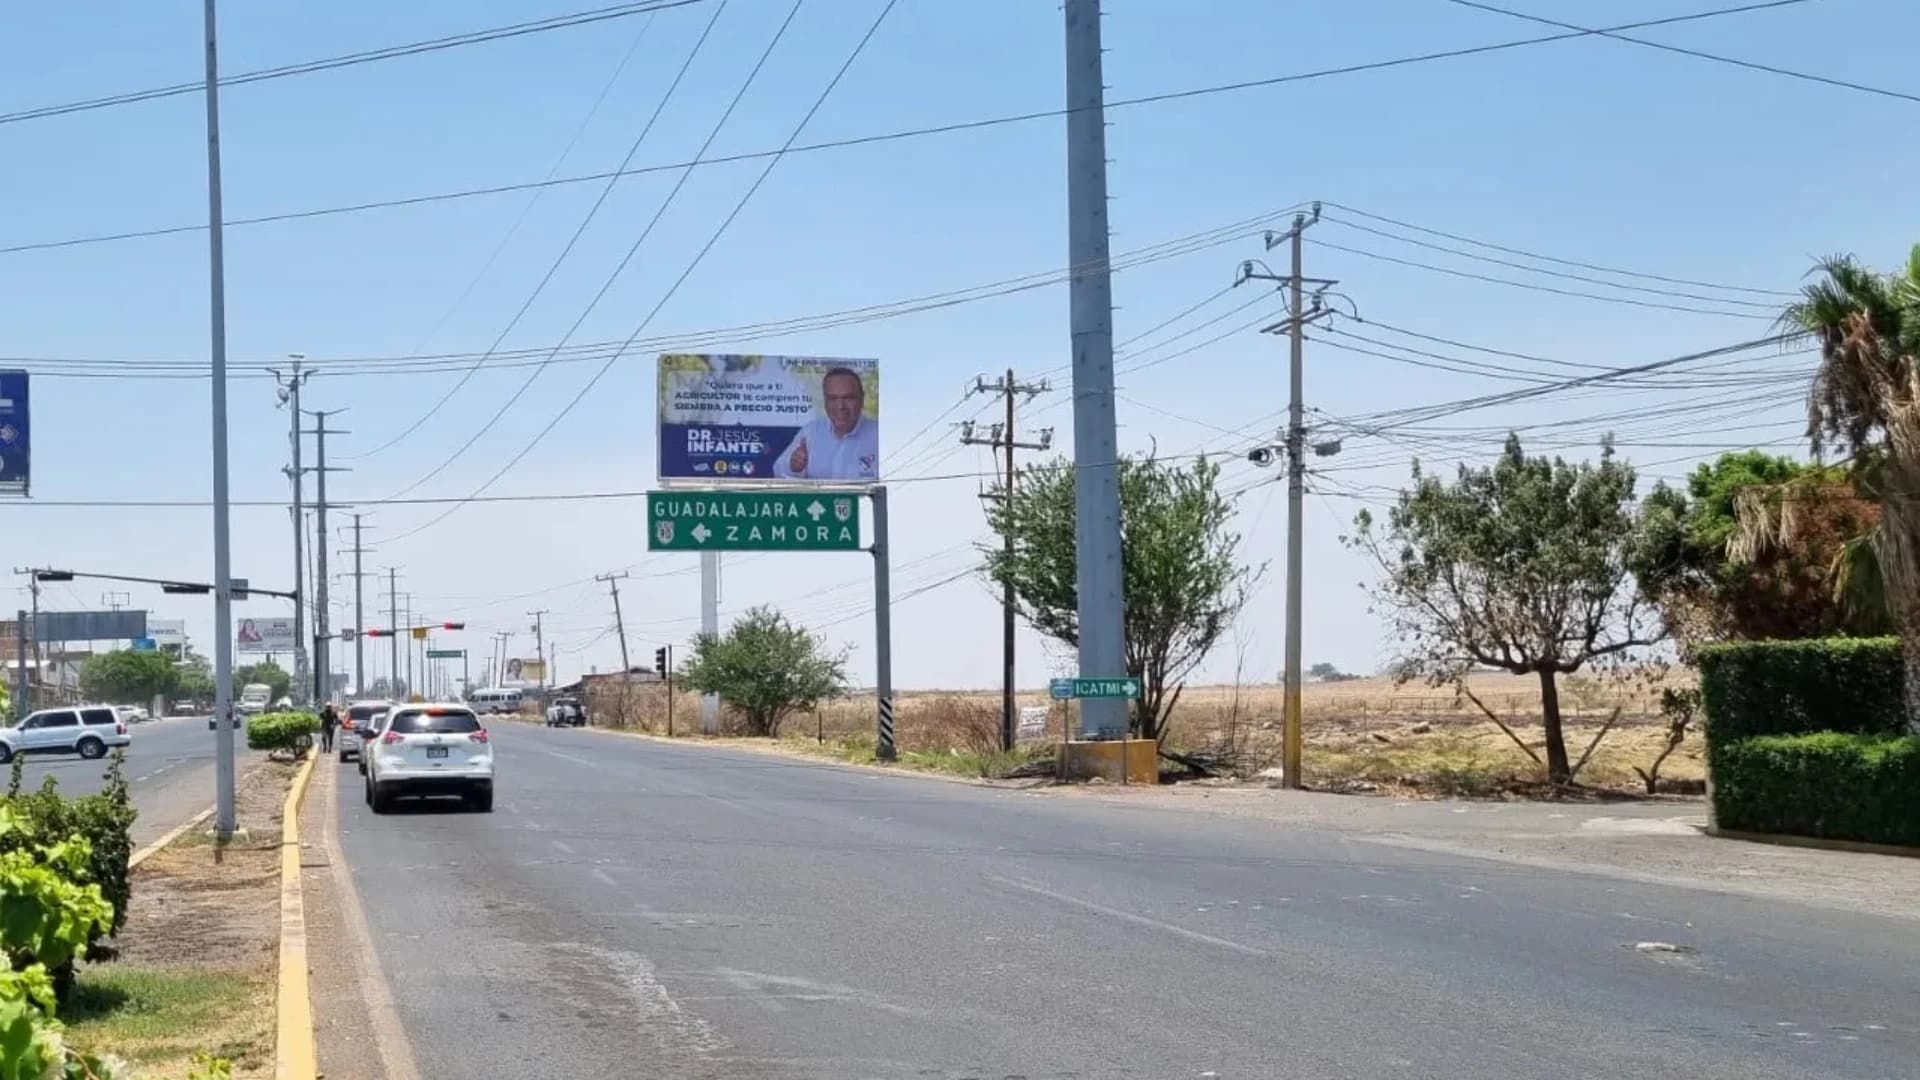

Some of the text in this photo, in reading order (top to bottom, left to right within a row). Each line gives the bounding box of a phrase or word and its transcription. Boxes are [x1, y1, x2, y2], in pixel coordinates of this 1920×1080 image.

[675, 392, 740, 400] AGRICULTOR
[674, 402, 721, 411] SIEMBRA
[723, 403, 732, 411] A
[734, 404, 773, 412] PRECIO
[718, 427, 760, 442] JESÚS
[687, 441, 762, 454] INFANTE
[655, 501, 799, 518] GUADALAJARA
[725, 525, 851, 541] ZAMORA
[1075, 682, 1120, 695] ICATMI
